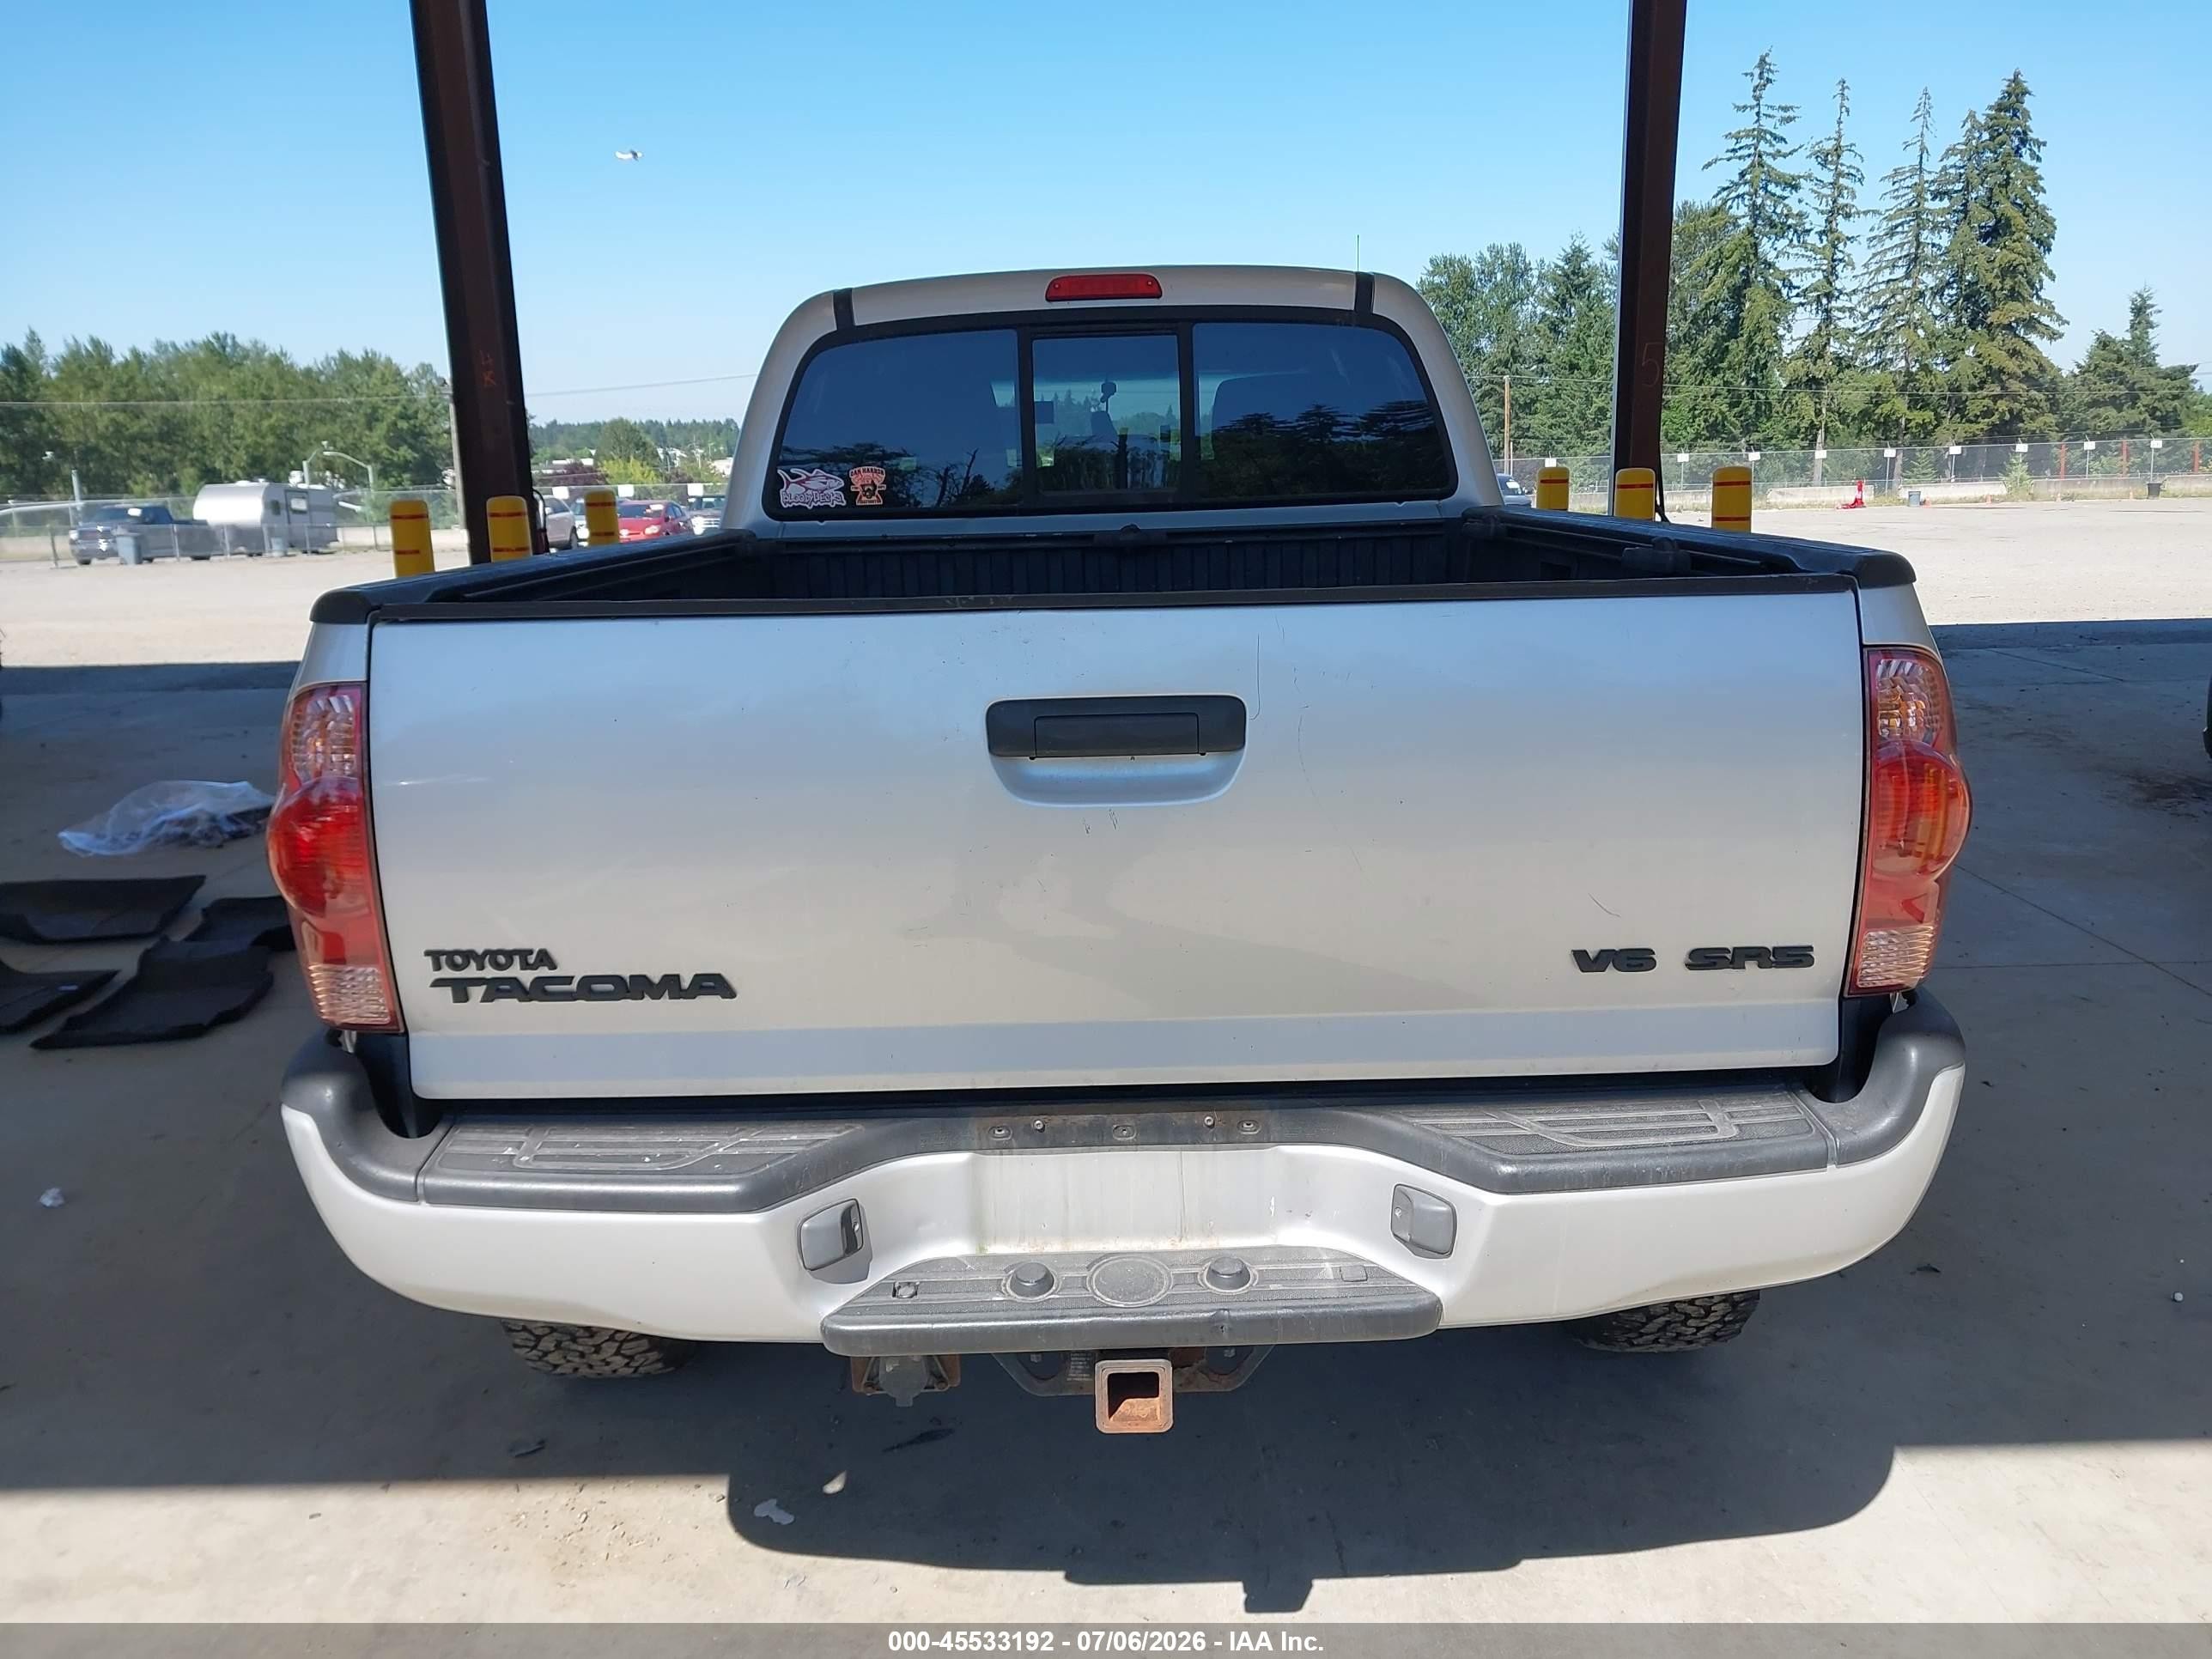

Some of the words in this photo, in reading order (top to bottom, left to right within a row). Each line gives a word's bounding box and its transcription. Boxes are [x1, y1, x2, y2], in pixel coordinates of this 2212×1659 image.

[423, 948, 558, 971] TOYOTA
[1571, 948, 1656, 973] V6
[1685, 945, 1814, 971] SR5
[429, 972, 738, 1004] TACOMA
